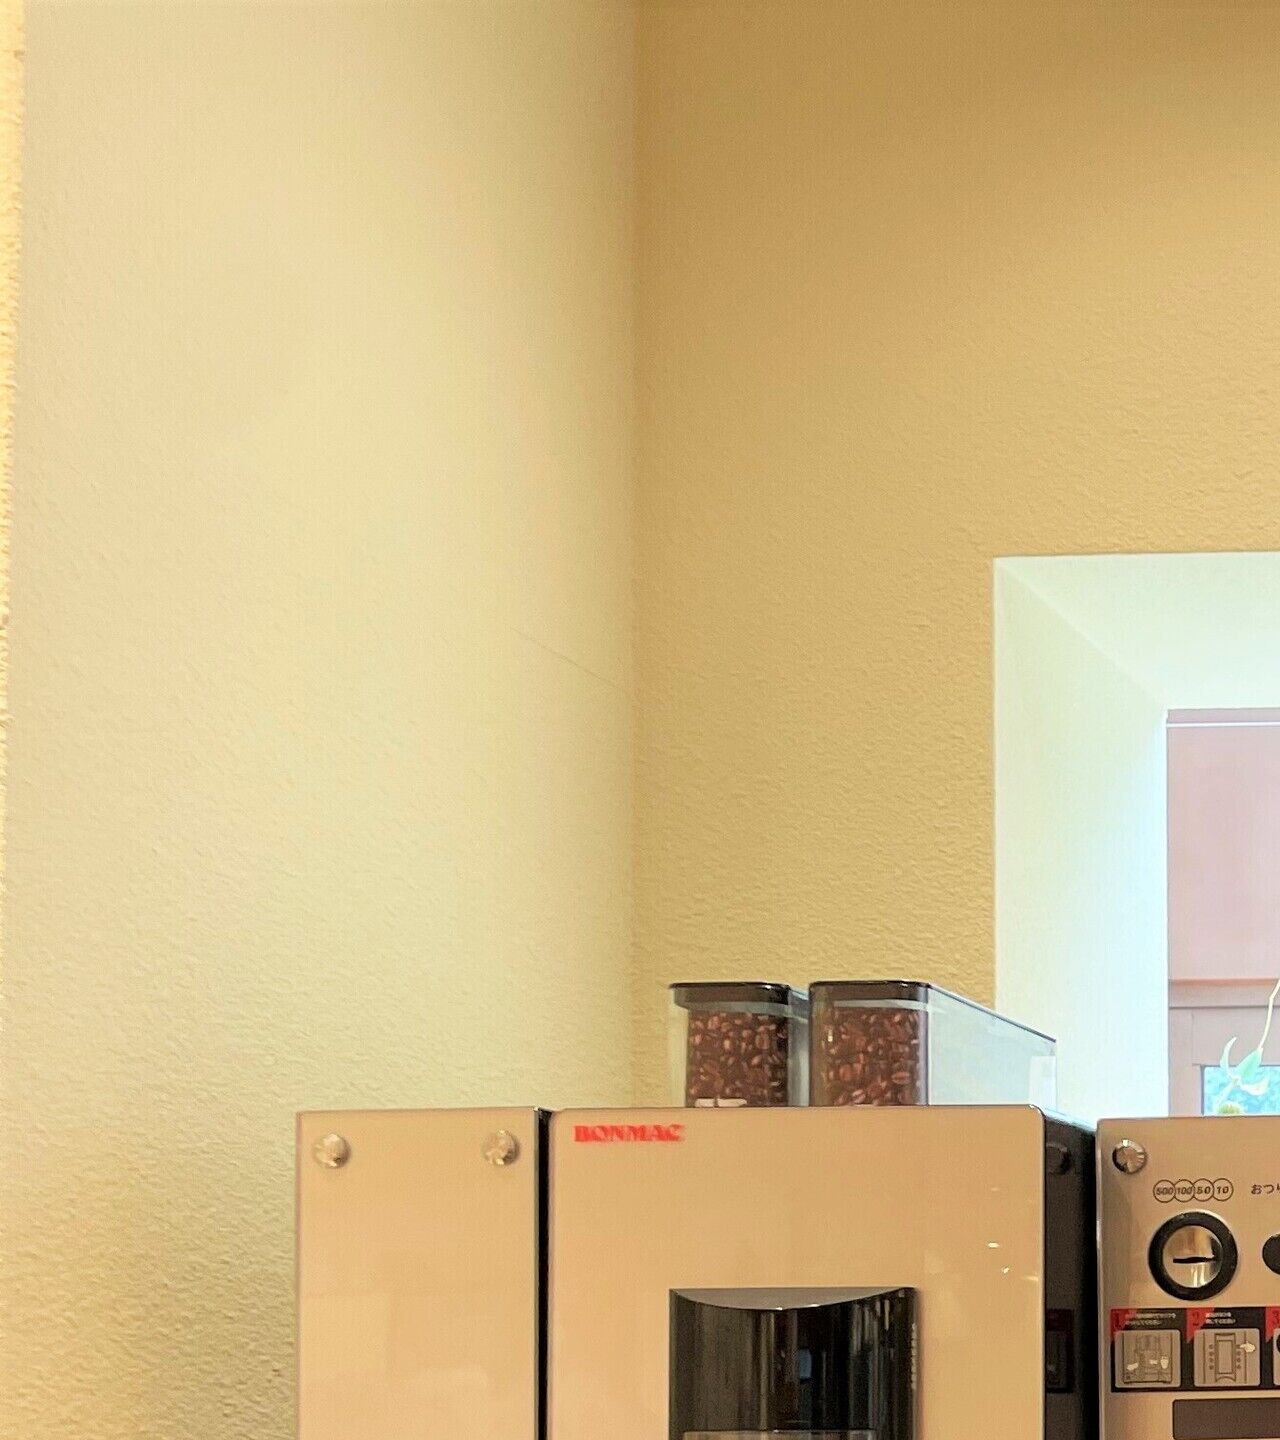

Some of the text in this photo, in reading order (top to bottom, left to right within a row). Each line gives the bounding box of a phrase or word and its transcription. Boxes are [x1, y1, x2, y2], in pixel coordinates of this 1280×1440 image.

[574, 1124, 684, 1142] BONMAC
[1156, 1184, 1229, 1195] 500 100 50 10
